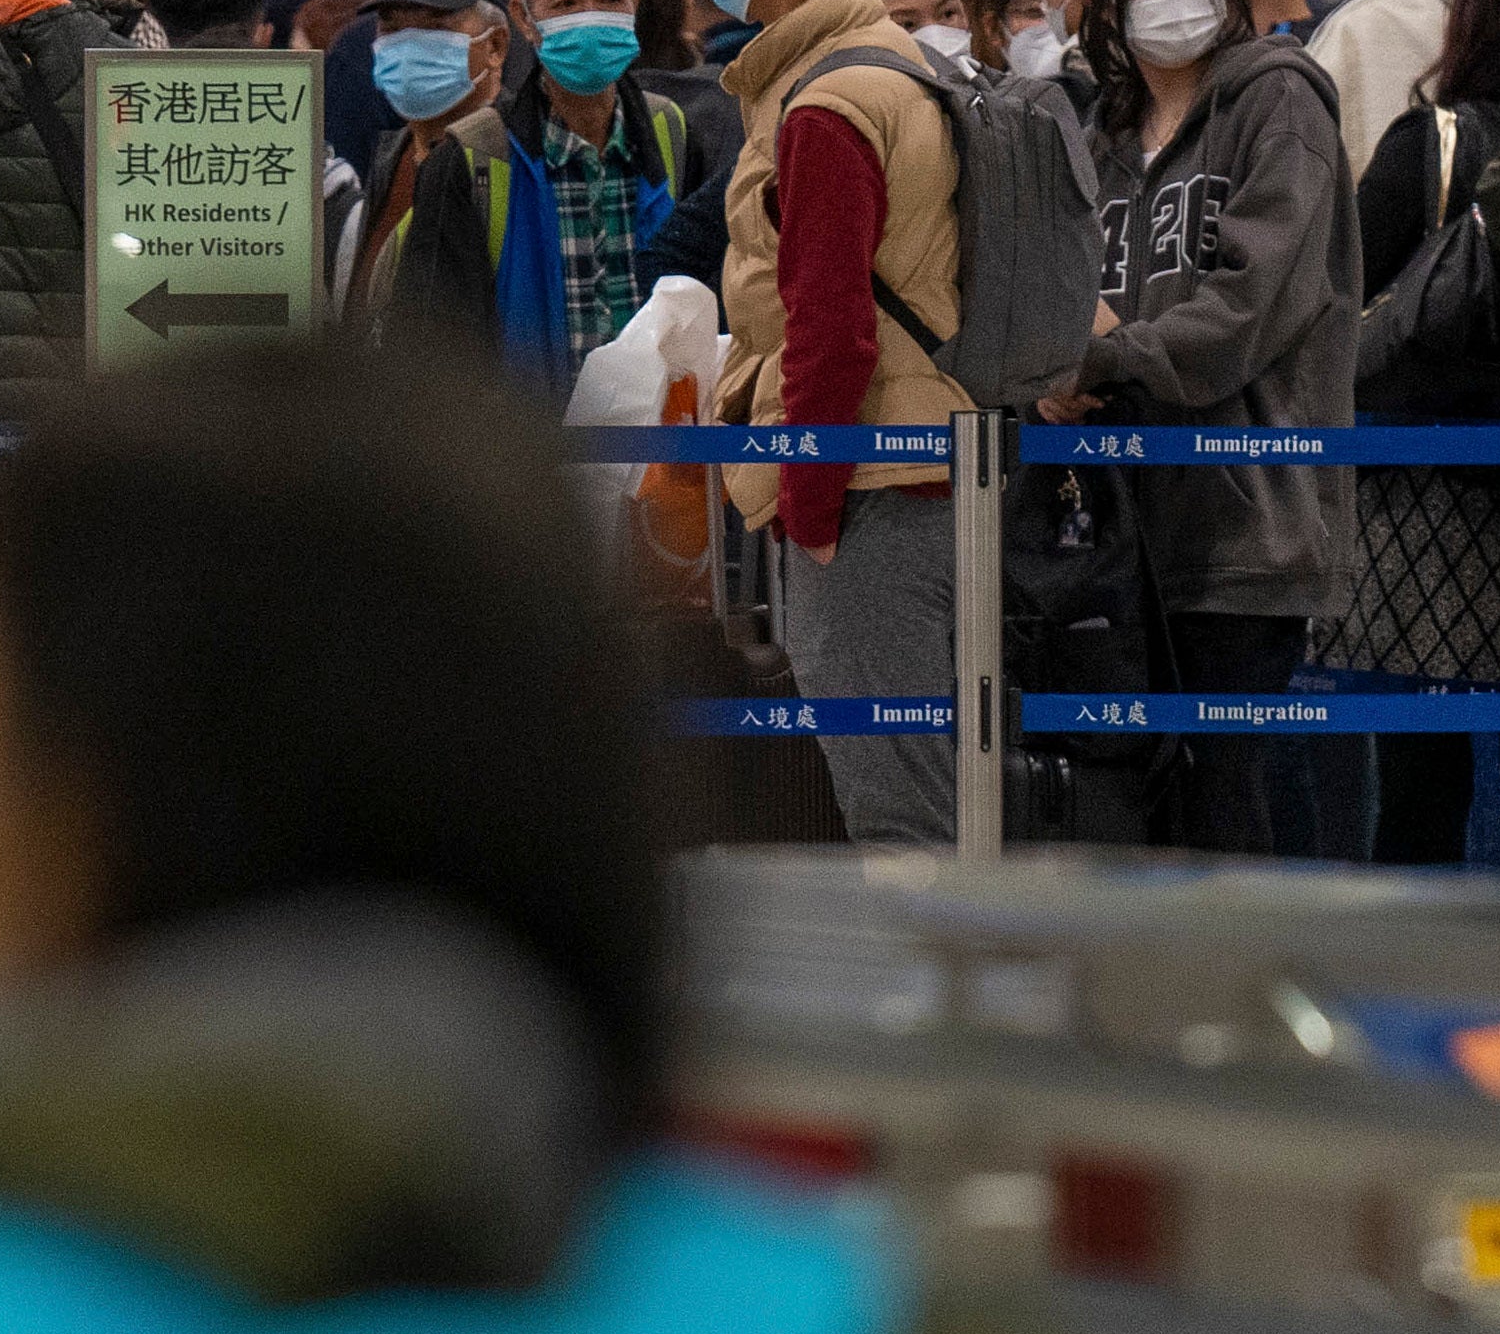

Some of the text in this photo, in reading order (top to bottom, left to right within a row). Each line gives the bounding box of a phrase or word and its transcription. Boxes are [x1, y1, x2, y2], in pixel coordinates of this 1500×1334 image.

[108, 80, 307, 125] 香港居民/
[115, 142, 296, 188] 其他訪客
[124, 200, 289, 226] HK Residents /
[199, 236, 285, 257] Visitors
[741, 430, 821, 457] 入境處
[1072, 433, 1146, 459] 入境處
[1193, 432, 1324, 458] Immigration
[739, 703, 819, 731] 入境處
[1075, 700, 1149, 727] 入境處
[1197, 700, 1329, 725] Immigration
